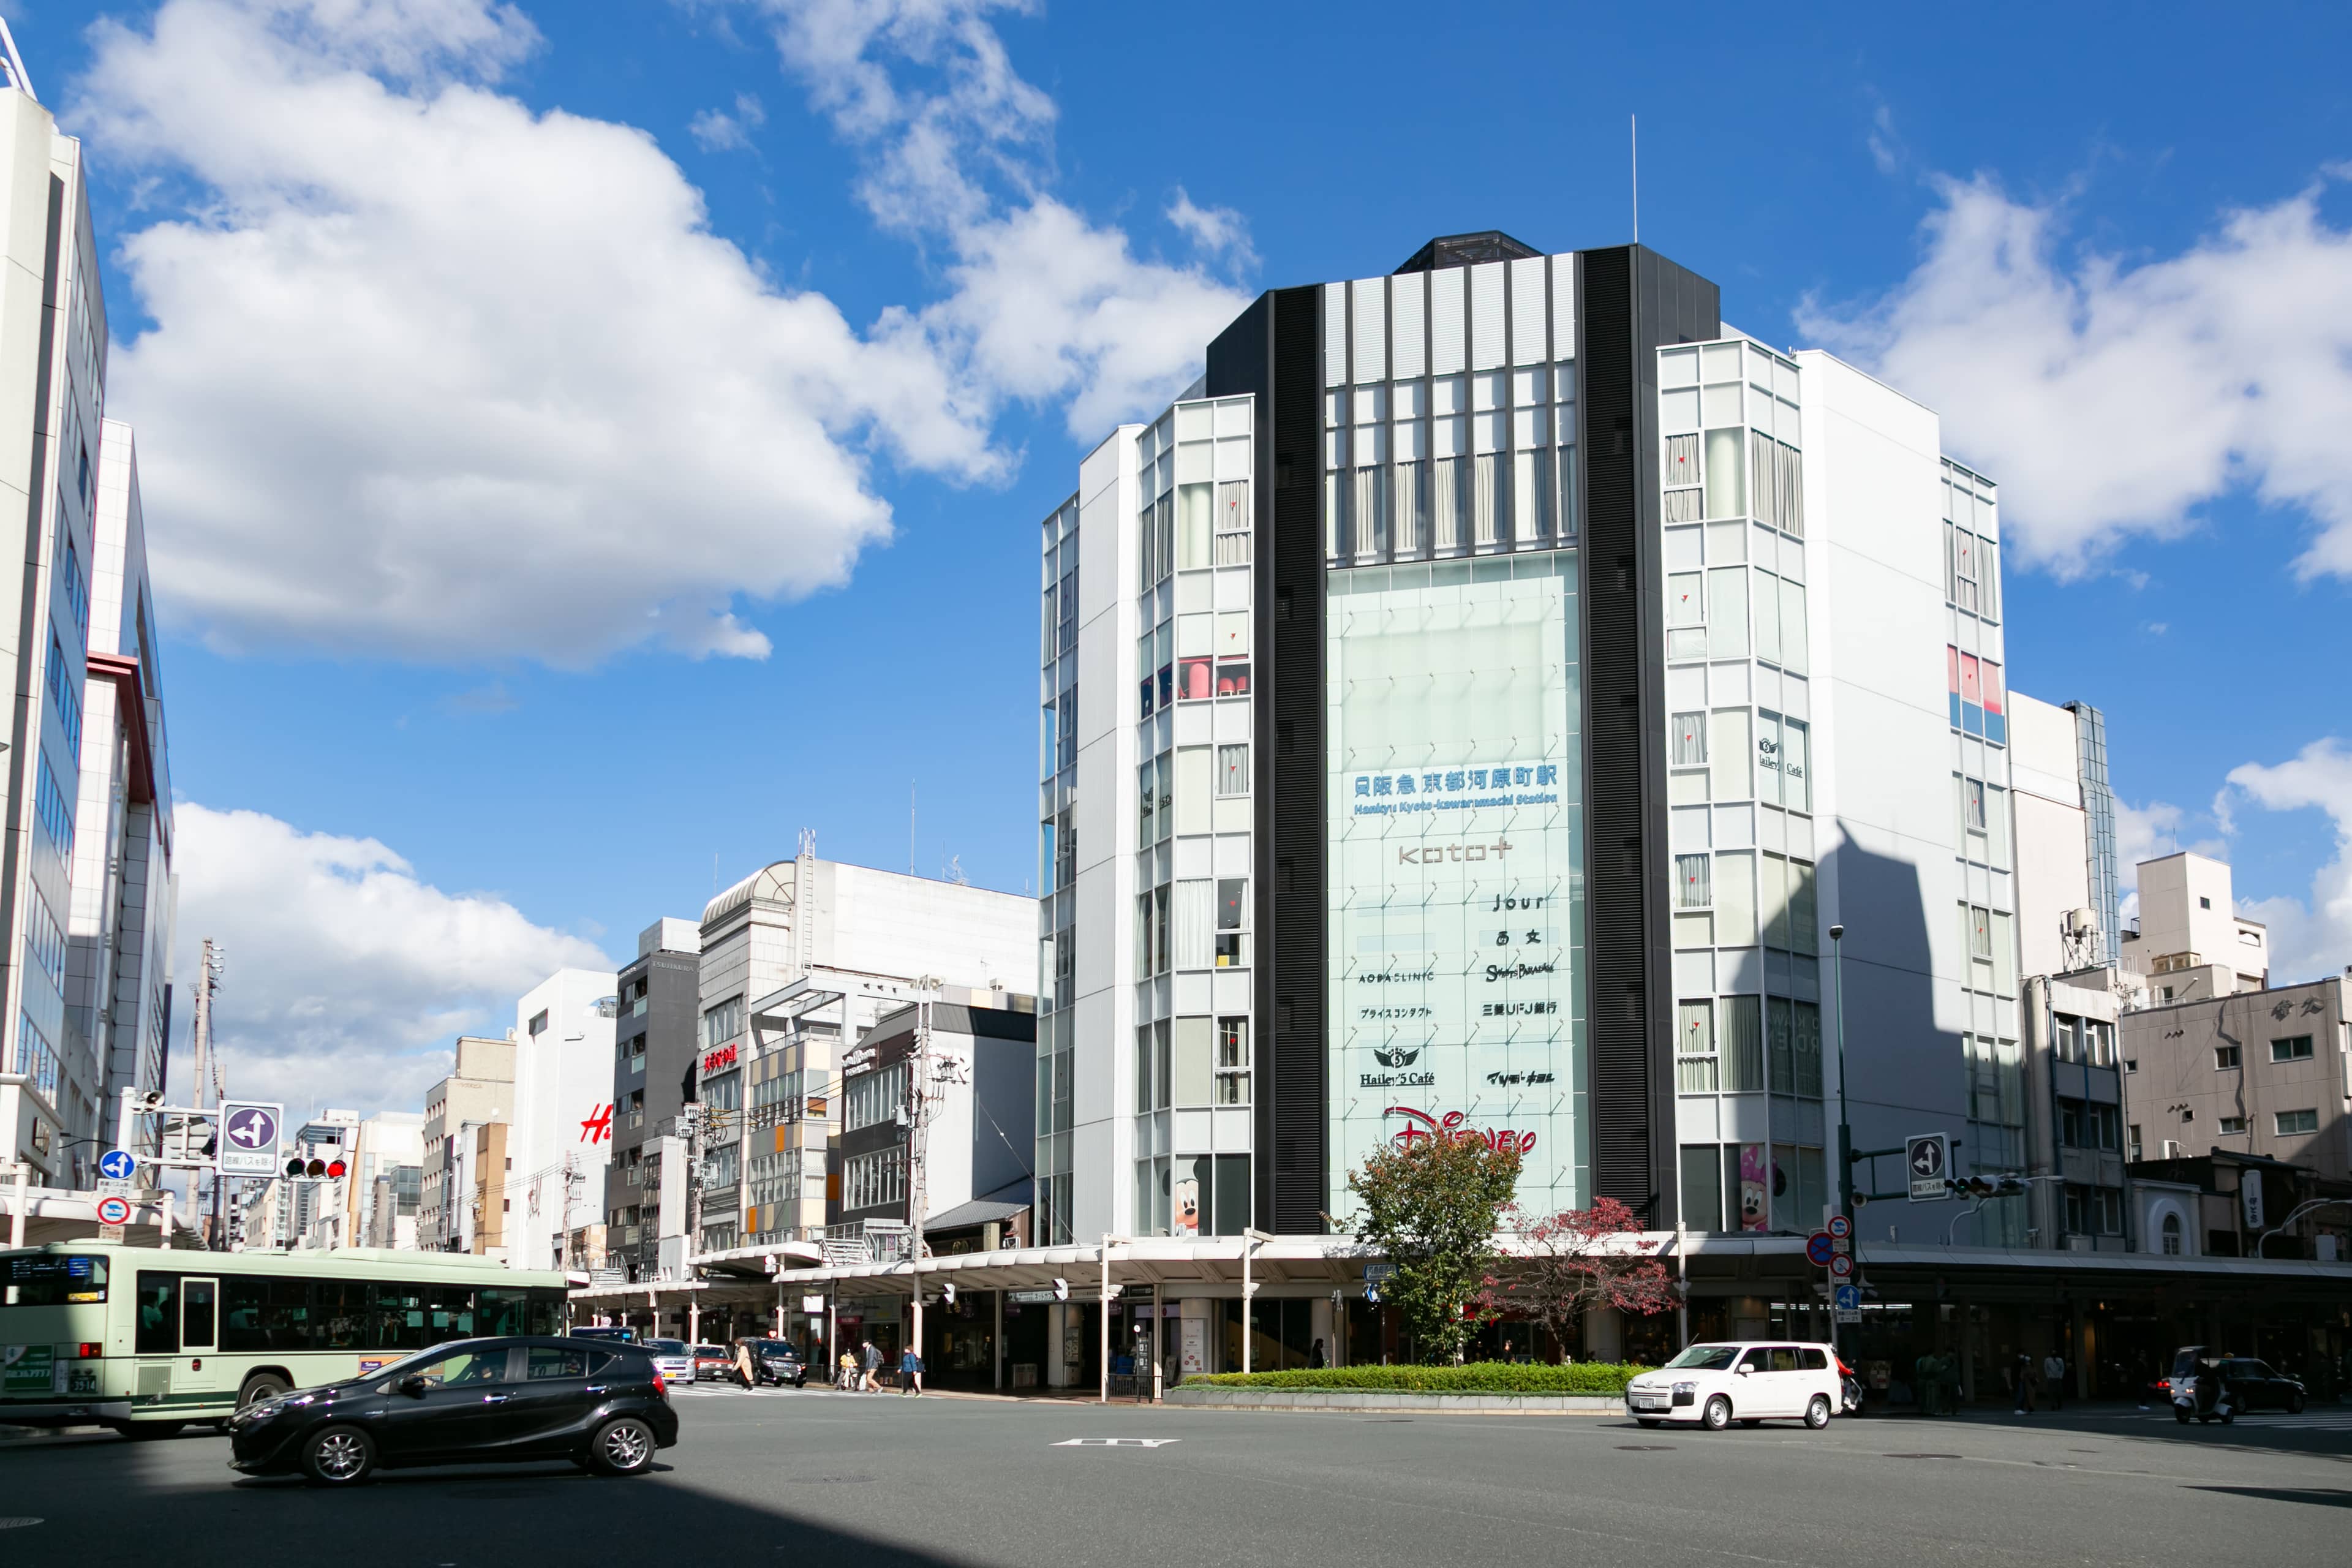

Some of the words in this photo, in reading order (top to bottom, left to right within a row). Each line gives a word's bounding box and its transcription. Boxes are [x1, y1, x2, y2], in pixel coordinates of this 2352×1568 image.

[1787, 763, 1803, 776] Café
[1373, 765, 1557, 796] 阪急京都河原町駅
[1354, 803, 1396, 815] Hankyu
[1400, 796, 1513, 813] Kyoto-kawaramachi
[1516, 792, 1558, 805] Station
[1360, 1007, 1433, 1020] プライスコンタクト
[1482, 1001, 1557, 1017] 三菱UFJ銀行
[1360, 1073, 1407, 1087] Hailey'5
[1409, 1072, 1435, 1084] Café
